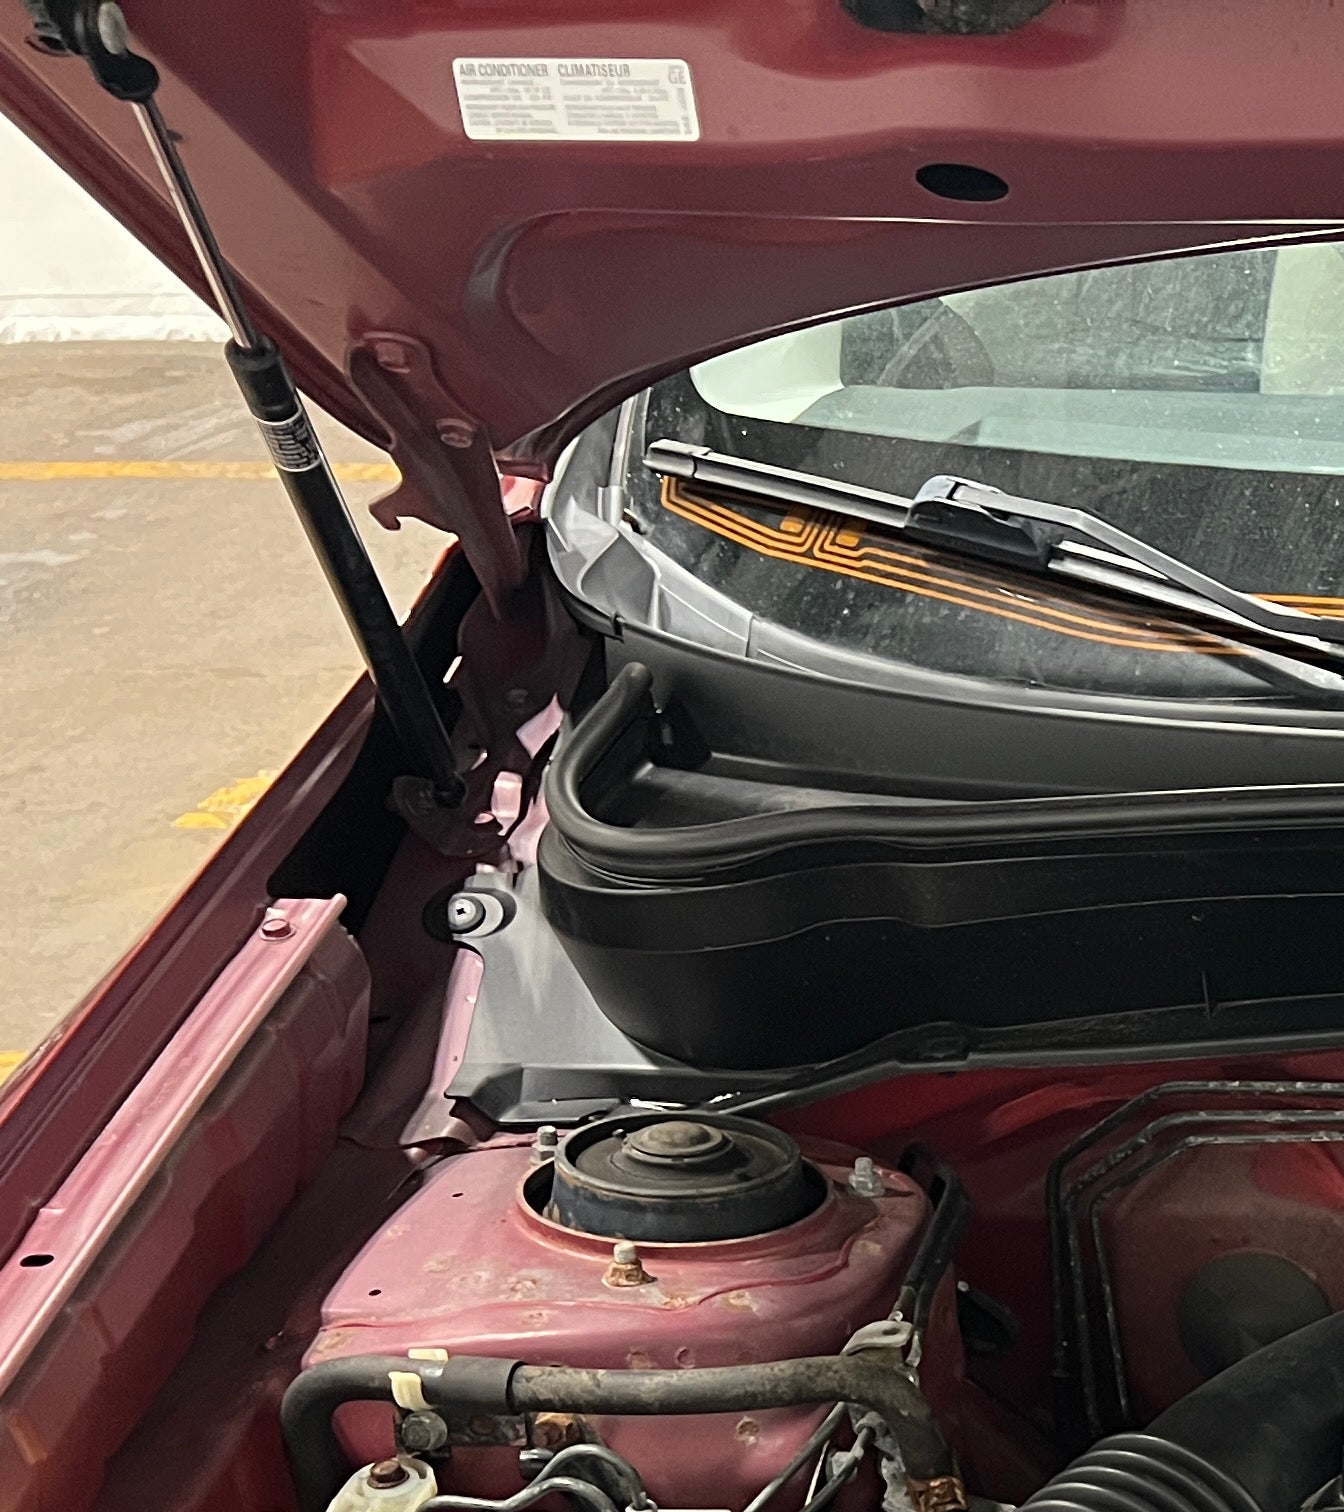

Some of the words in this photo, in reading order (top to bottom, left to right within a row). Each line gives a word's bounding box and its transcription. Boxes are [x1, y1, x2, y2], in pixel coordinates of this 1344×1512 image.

[459, 63, 476, 77] AIR
[478, 63, 549, 77] CONDITIONER
[557, 63, 631, 77] CLIMATISEUR
